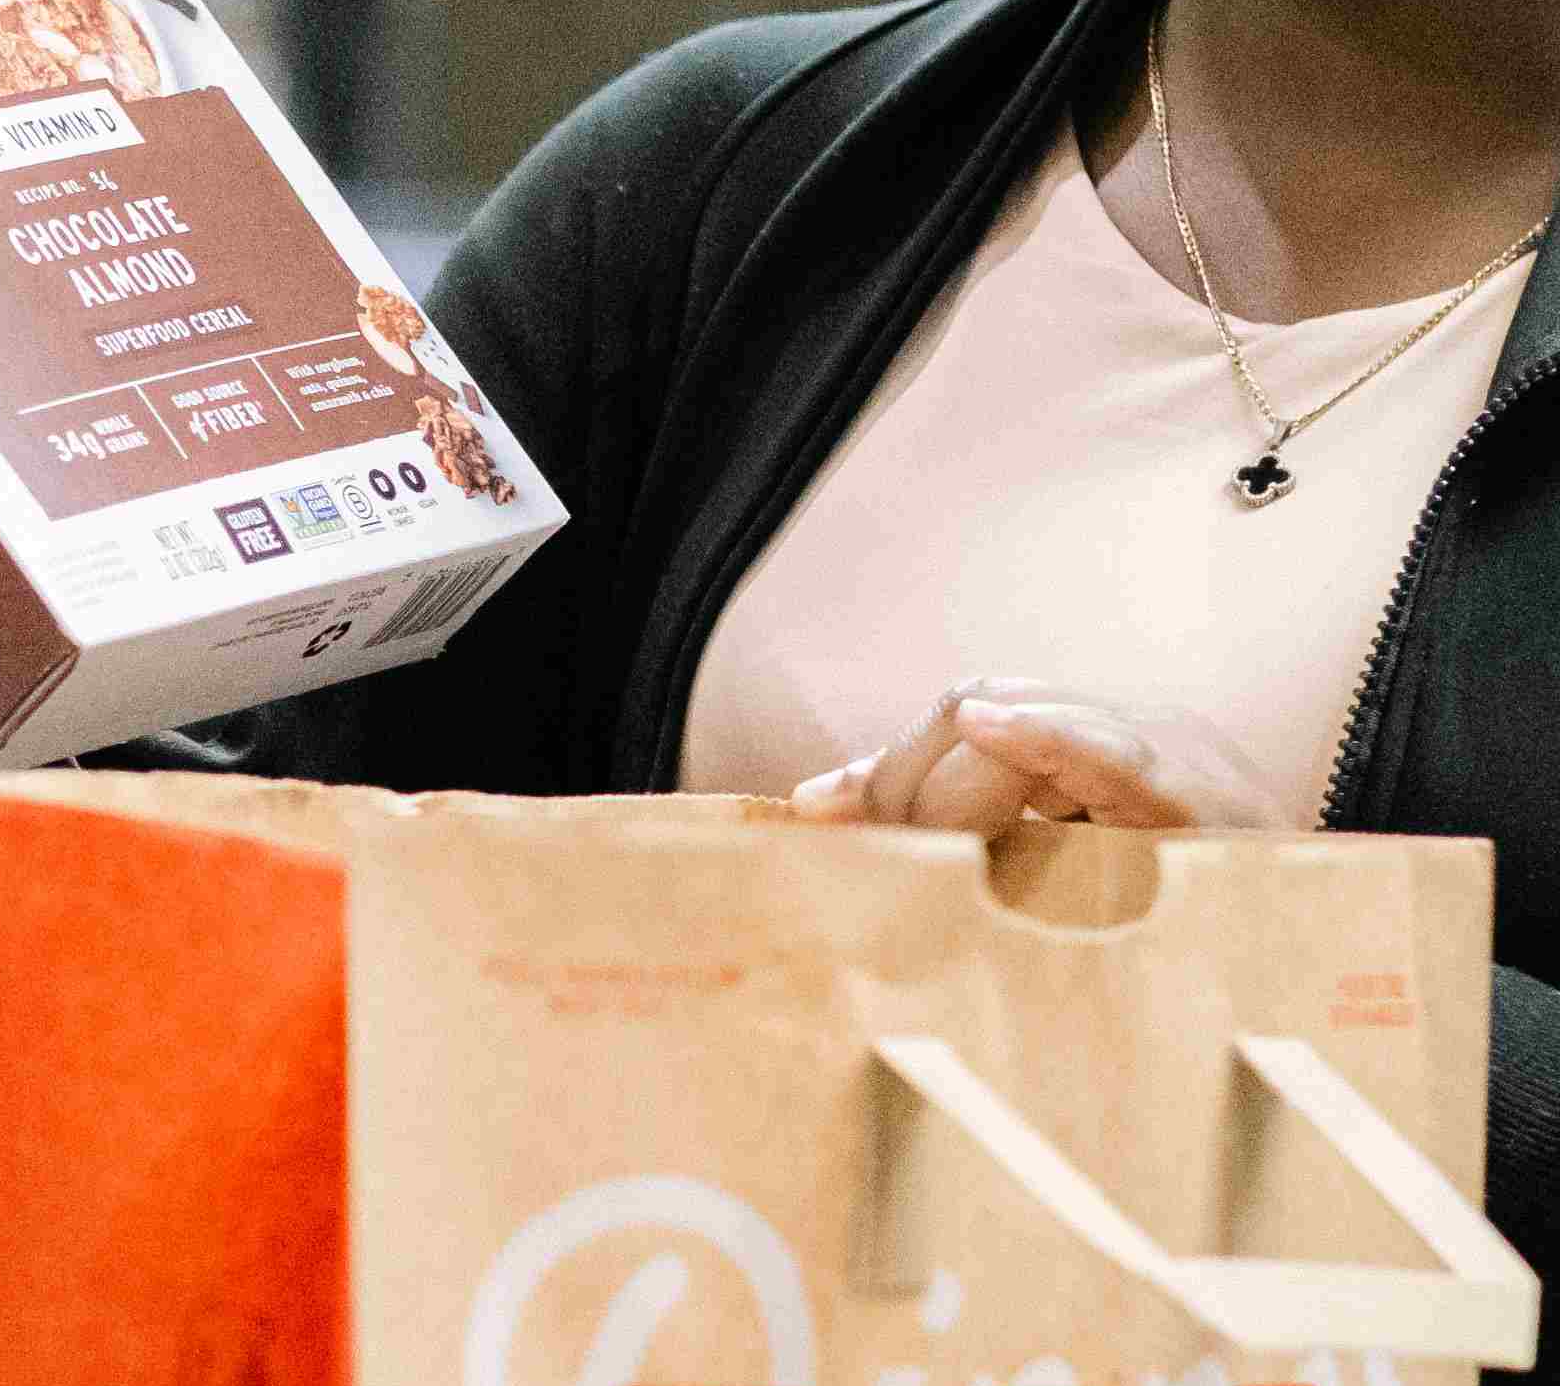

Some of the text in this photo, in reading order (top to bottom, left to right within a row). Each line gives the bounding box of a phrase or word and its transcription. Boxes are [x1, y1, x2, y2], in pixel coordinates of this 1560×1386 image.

[2, 106, 118, 152] VITAMIN D
[14, 180, 63, 206] RECIPE
[8, 195, 190, 265] CHOCOLATE
[66, 247, 198, 309] ALMOND
[94, 304, 255, 357] SUPERFOOD CEREAL
[46, 429, 107, 462] 34g
[237, 526, 282, 557] FREE
